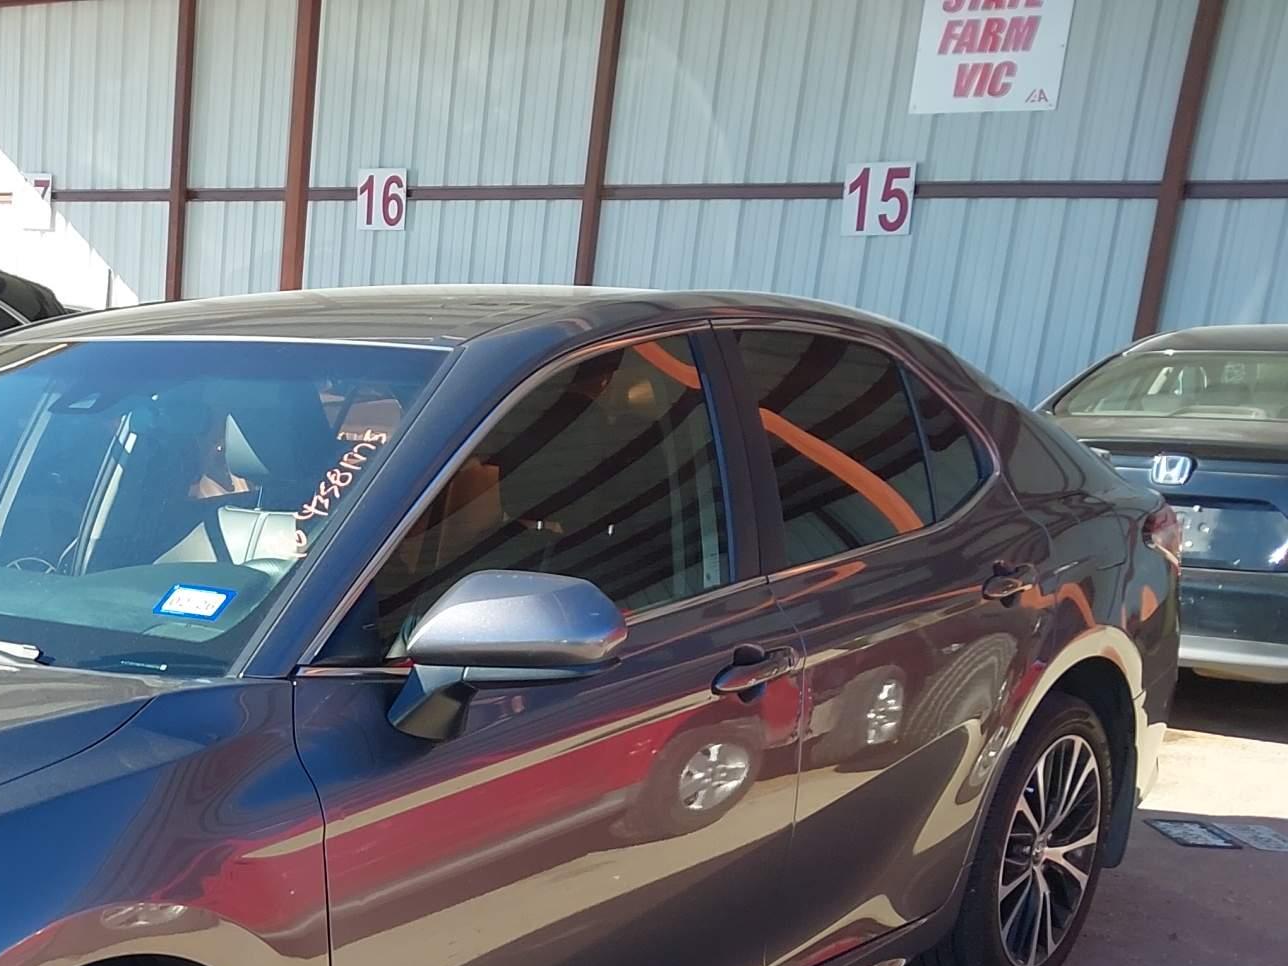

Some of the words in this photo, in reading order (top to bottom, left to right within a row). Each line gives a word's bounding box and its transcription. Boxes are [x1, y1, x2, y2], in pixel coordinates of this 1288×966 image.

[937, 15, 1042, 55] FARM
[952, 60, 1017, 98] VIC
[359, 174, 404, 226] 16
[848, 167, 911, 232] 15
